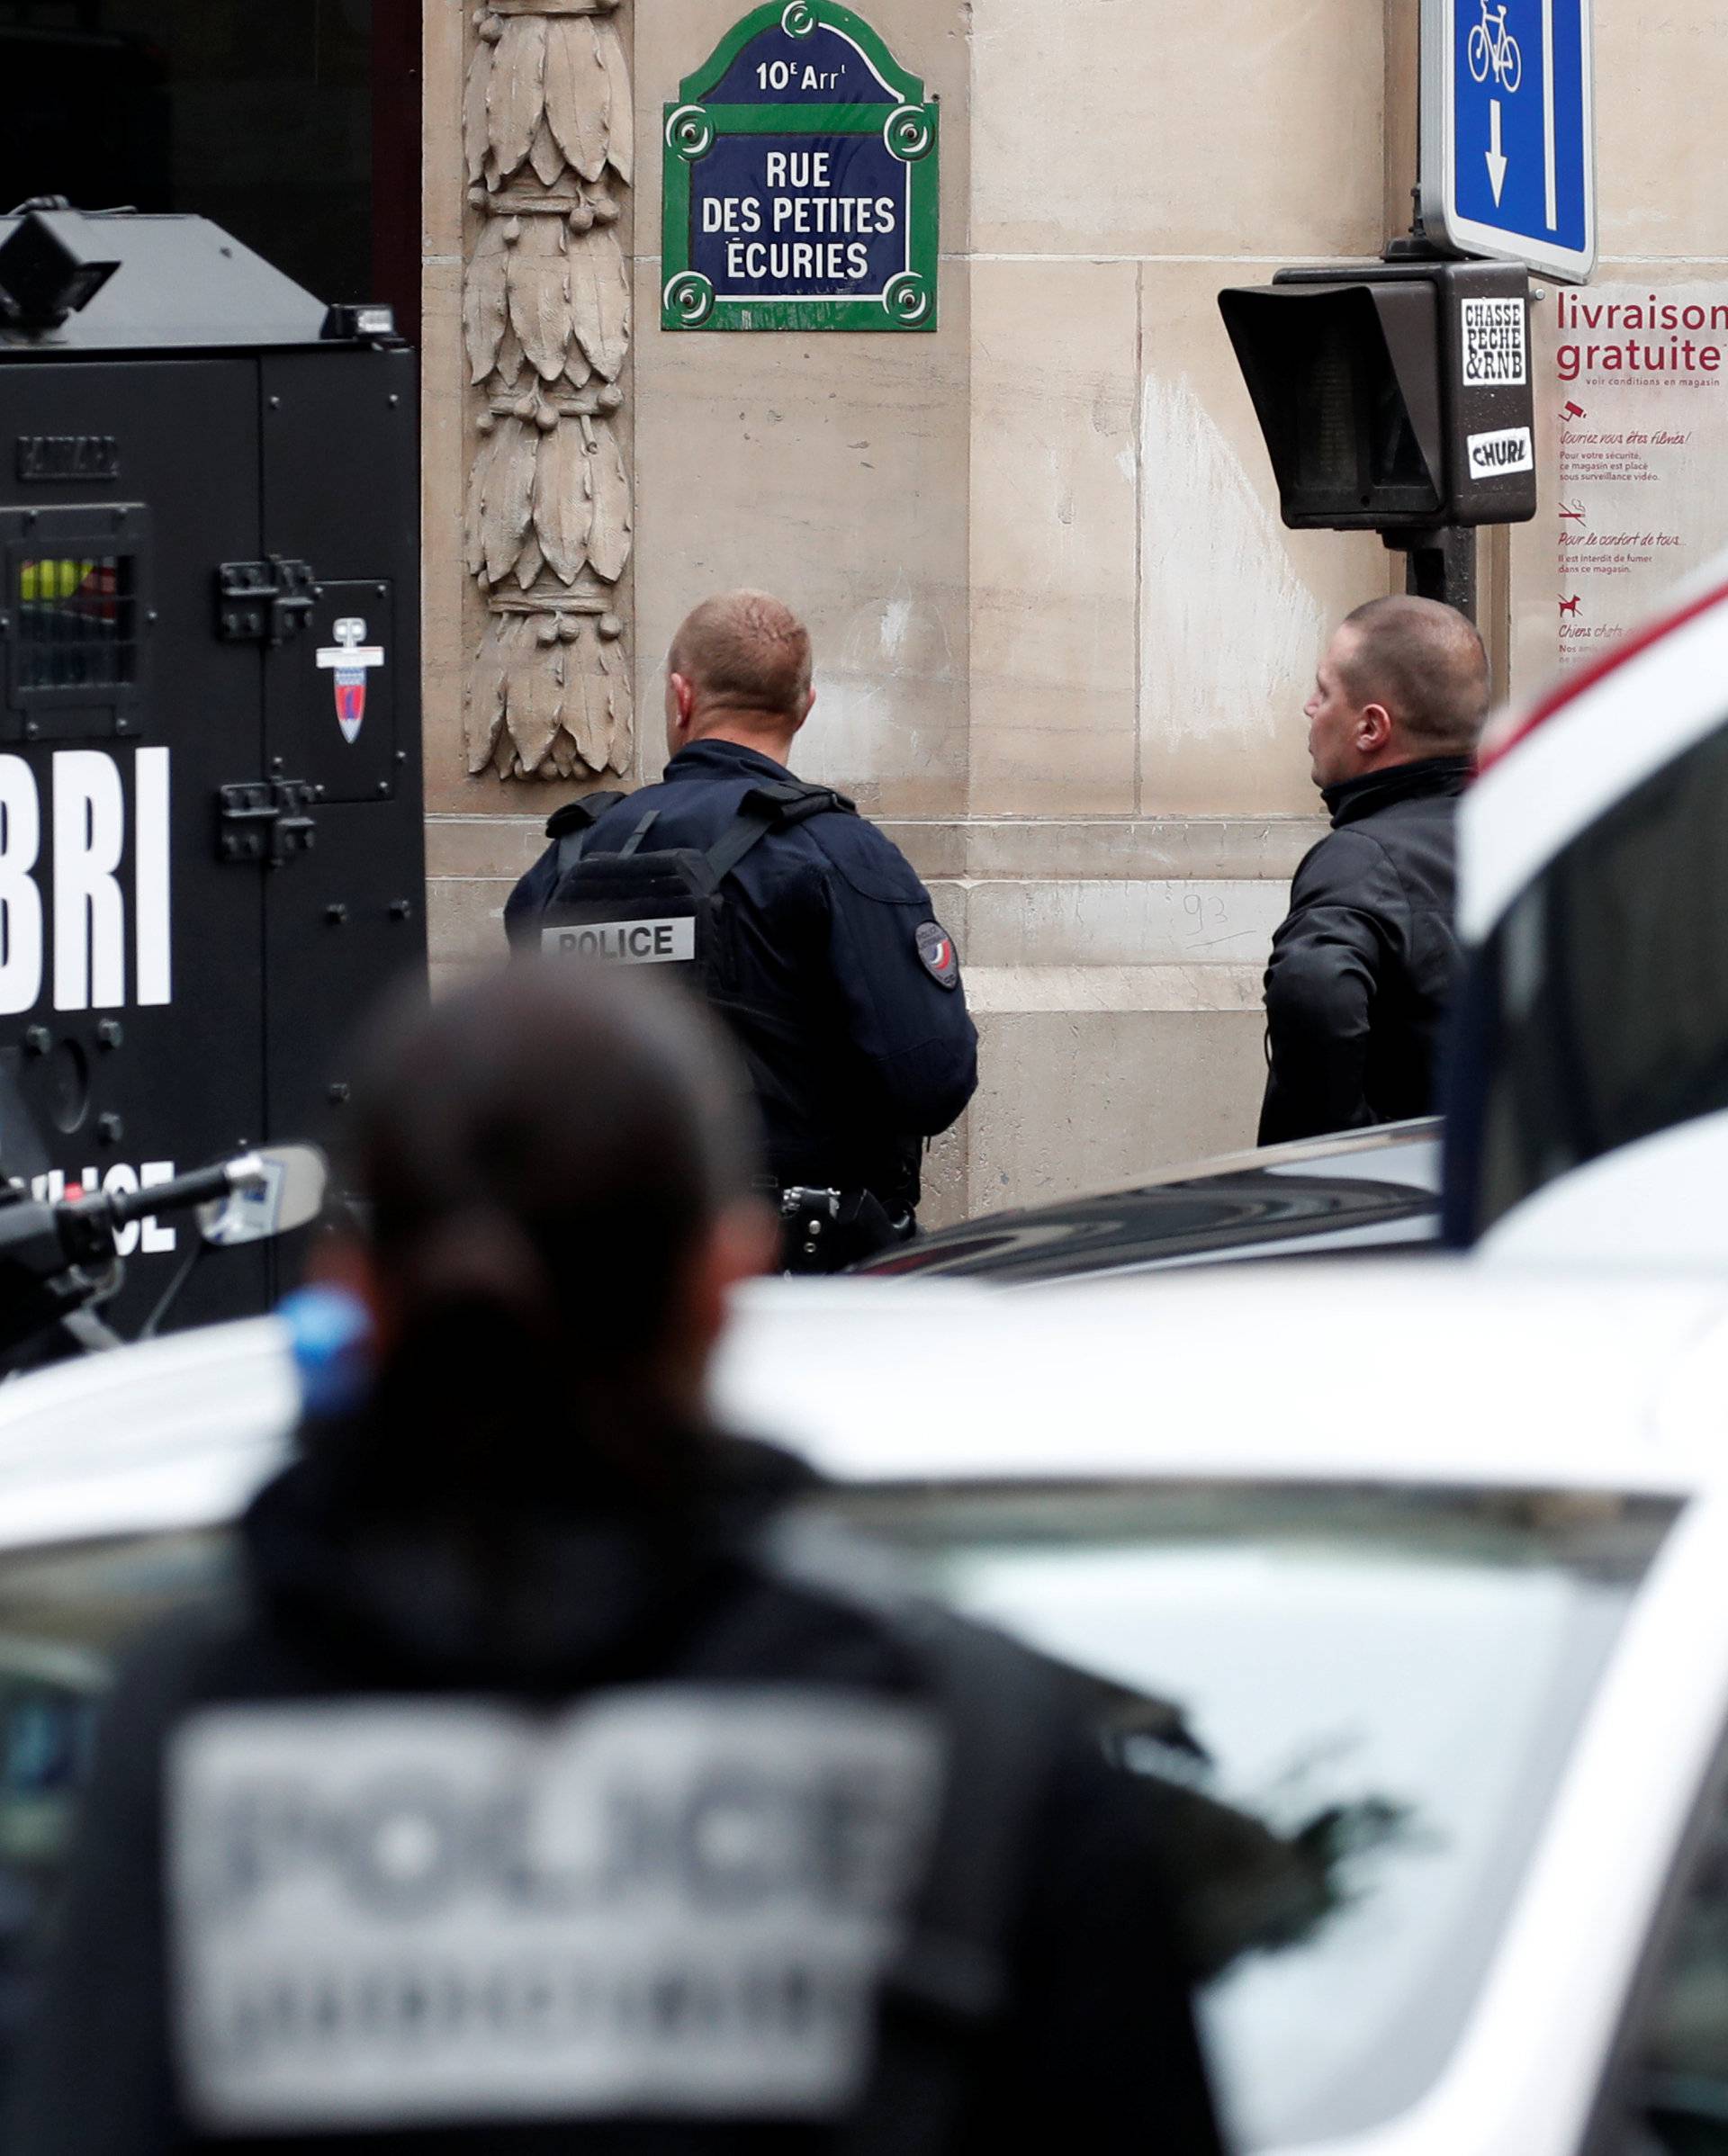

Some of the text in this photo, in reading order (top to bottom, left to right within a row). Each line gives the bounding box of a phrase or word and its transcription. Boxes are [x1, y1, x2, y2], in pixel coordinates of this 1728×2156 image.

[767, 151, 831, 188] RUE
[703, 196, 896, 234] DES PETITES
[725, 237, 868, 279] ÉCURIES
[1465, 304, 1521, 327] CHASSE
[1557, 292, 1728, 330] livraison
[1467, 327, 1522, 350] PECHE
[1679, 379, 1720, 388] magasin
[1560, 452, 1579, 460] Pour
[1581, 452, 1603, 460] votre
[1571, 463, 1607, 472] magasin
[1580, 472, 1632, 481] surveillance
[1558, 533, 1585, 545] Pour
[1586, 533, 1597, 544] le
[1599, 535, 1638, 545] confort
[1641, 533, 1653, 544] de
[1559, 624, 1591, 638] Chiens
